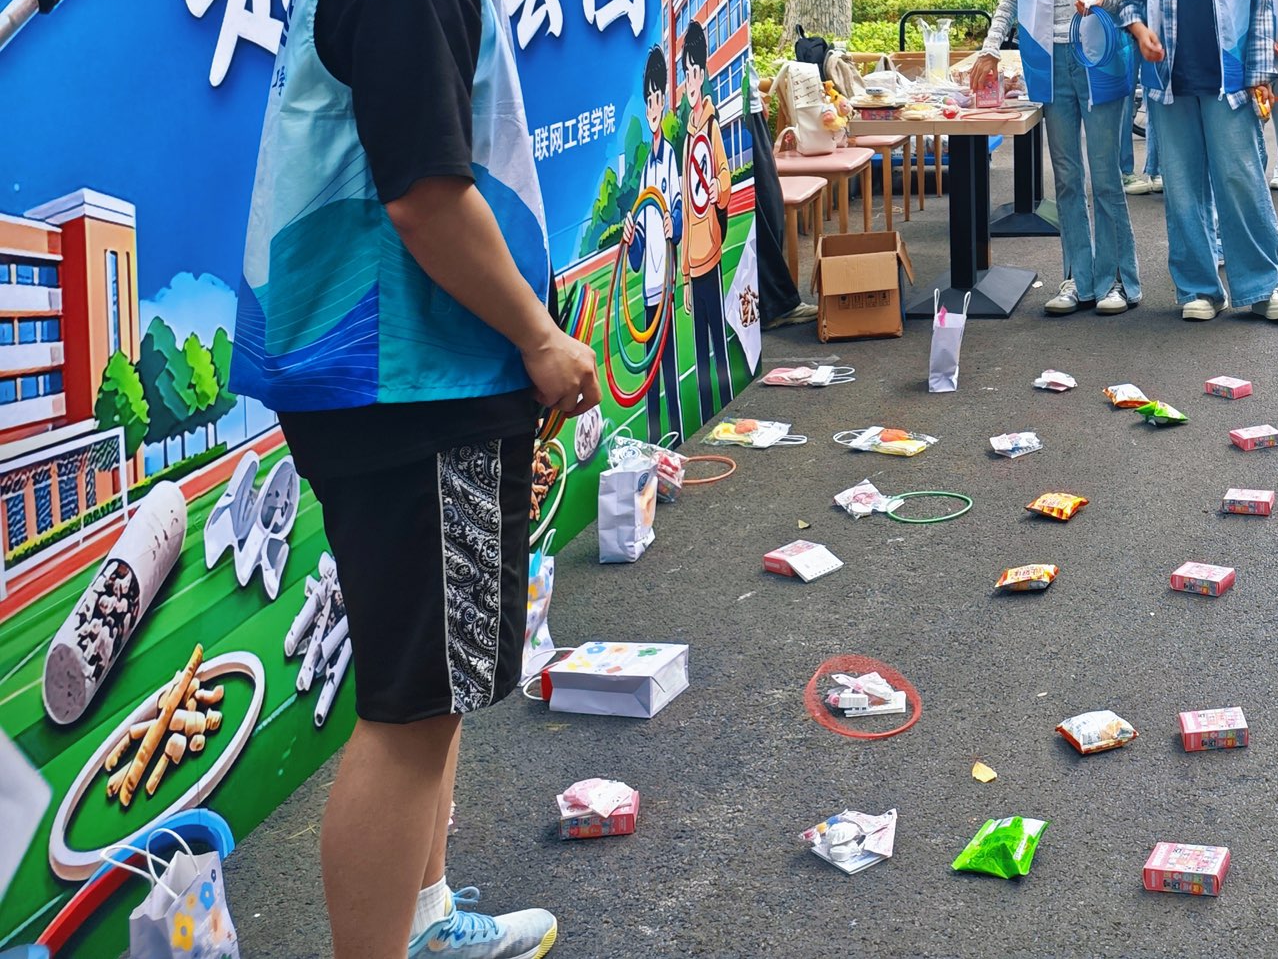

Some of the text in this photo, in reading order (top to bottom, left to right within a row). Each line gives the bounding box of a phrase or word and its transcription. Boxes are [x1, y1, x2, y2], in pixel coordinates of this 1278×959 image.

[529, 102, 616, 162] 联网工程学院
